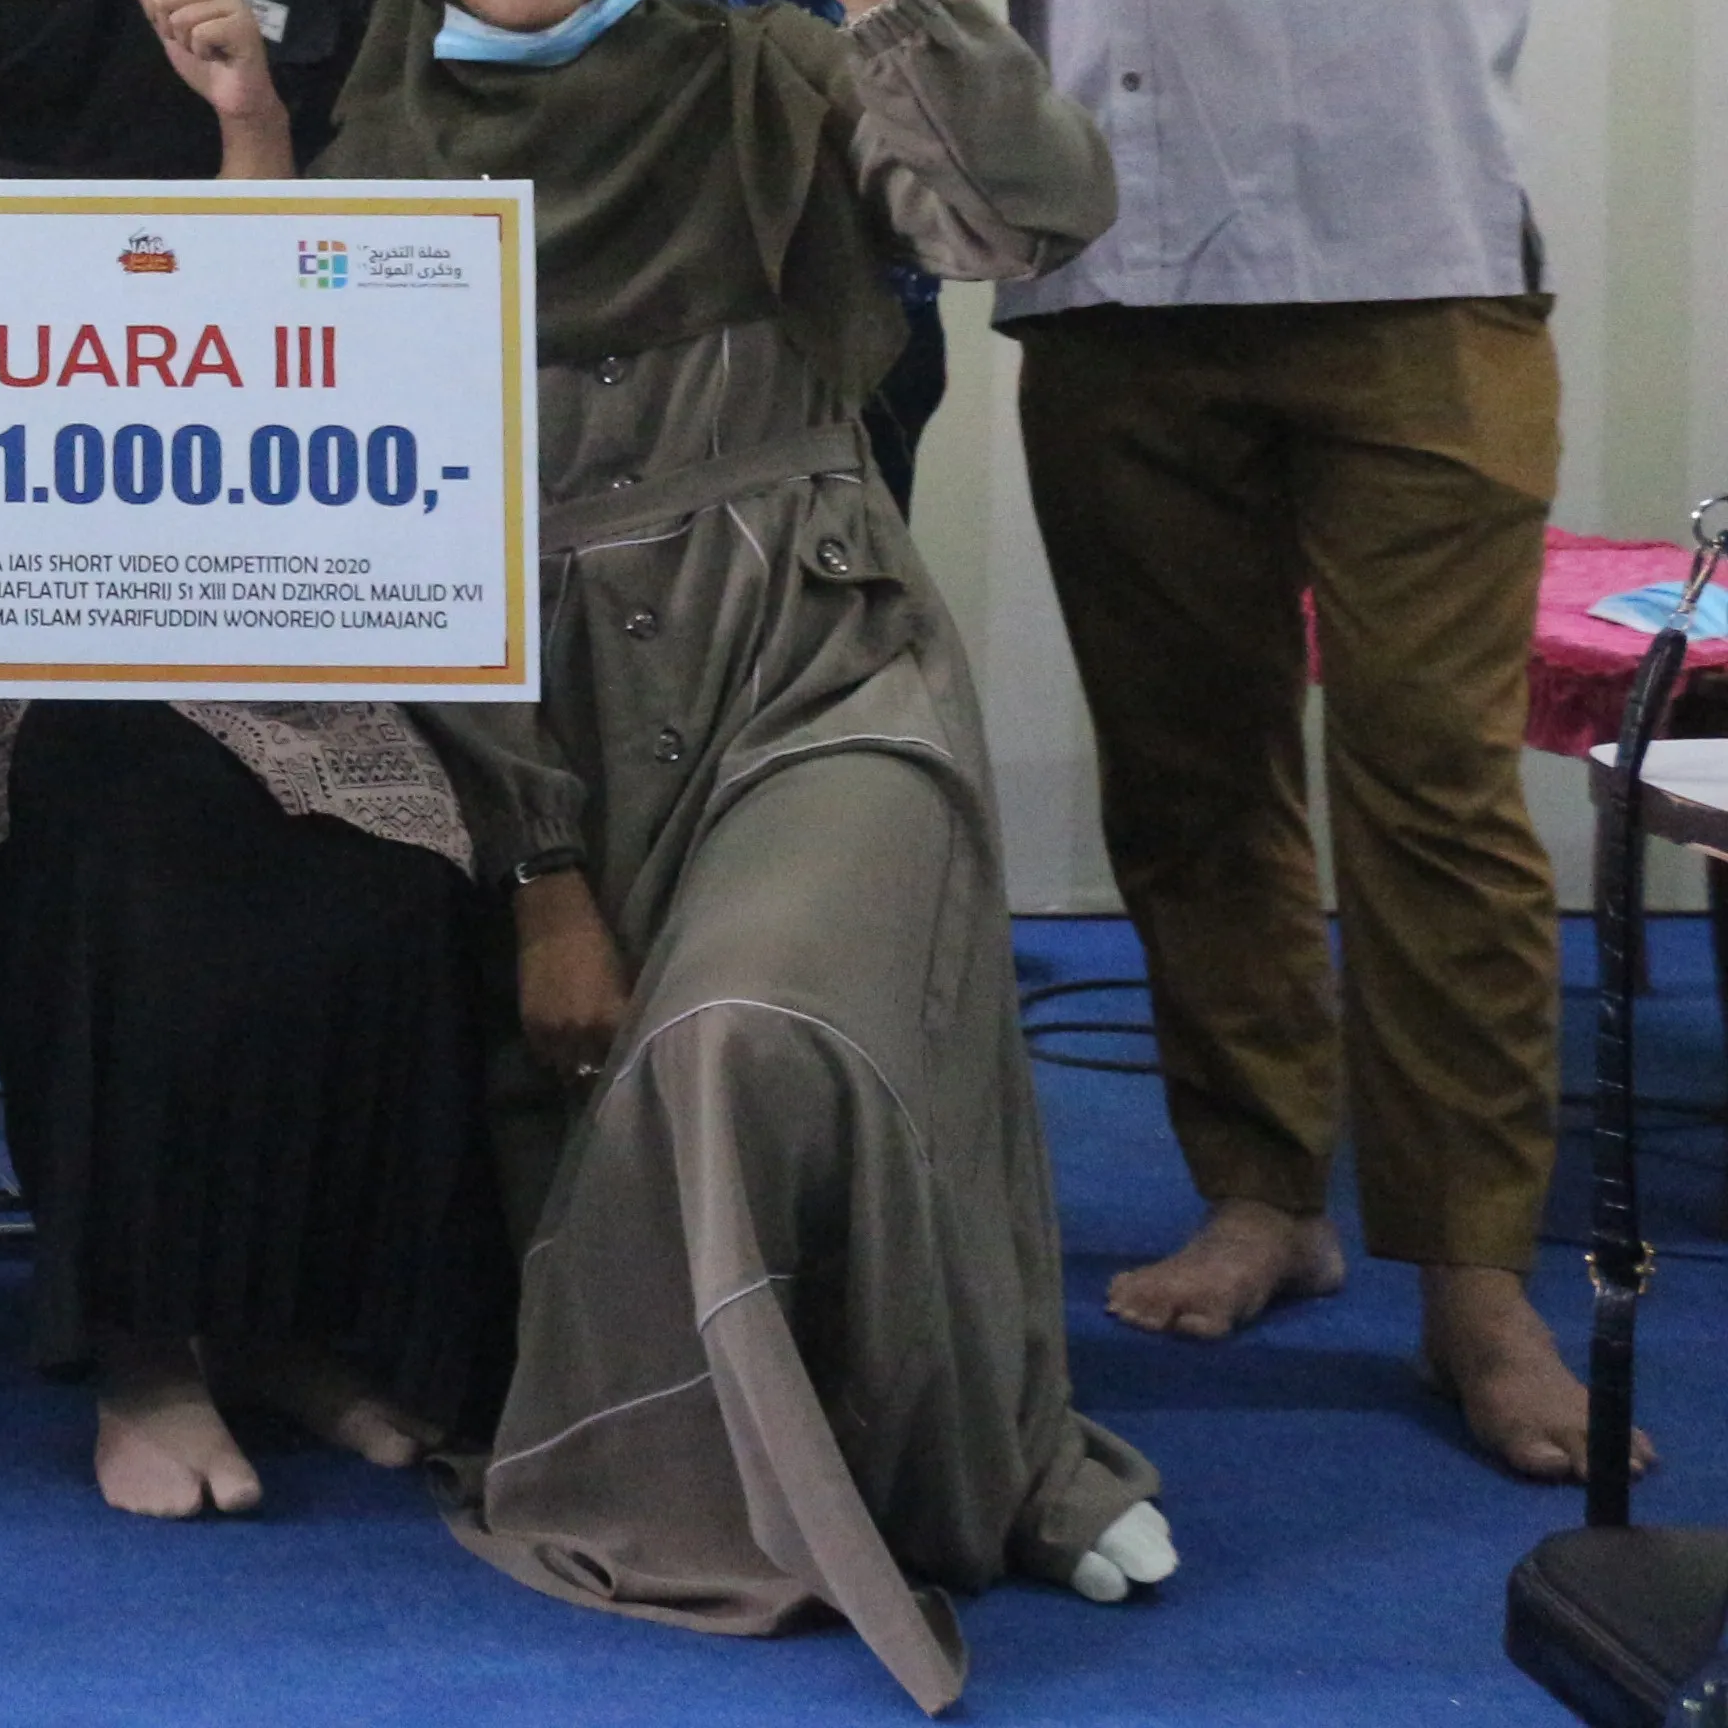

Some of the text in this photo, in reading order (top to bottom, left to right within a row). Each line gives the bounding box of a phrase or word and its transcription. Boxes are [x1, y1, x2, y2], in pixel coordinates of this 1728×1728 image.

[273, 325, 336, 388] III
[8, 553, 43, 572] IAIS
[48, 553, 114, 573] SHORT
[117, 553, 179, 573] VIDEO
[183, 554, 318, 574] COMPETITION
[323, 557, 371, 575] 2020
[94, 580, 172, 601] TAKHRIJ
[198, 581, 226, 600] XIII
[231, 581, 276, 601] DAN
[281, 581, 365, 602] DZIKROL
[370, 582, 447, 602] MAULID
[451, 583, 483, 602] XVI
[23, 607, 81, 627] ISLAM
[86, 607, 218, 628] SYARIFUDDIN
[222, 608, 336, 629] WONOREJO
[340, 609, 448, 630] LUMAJANG
